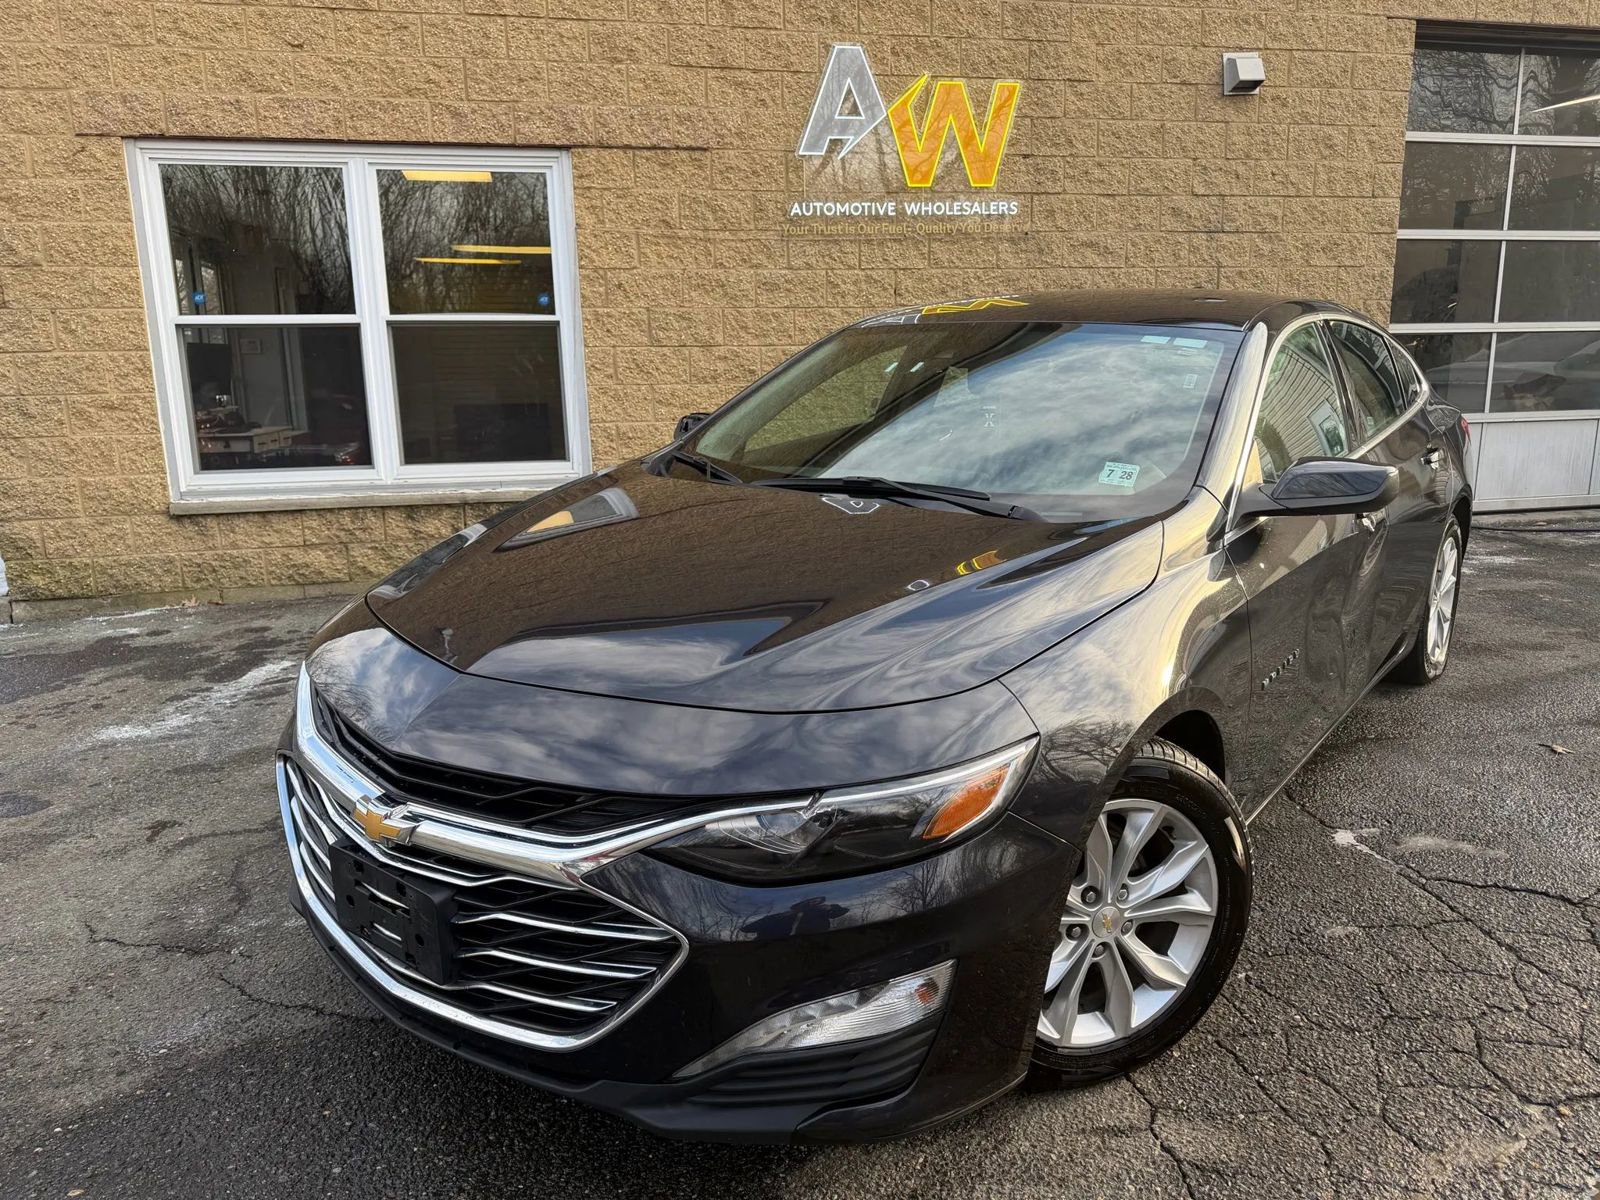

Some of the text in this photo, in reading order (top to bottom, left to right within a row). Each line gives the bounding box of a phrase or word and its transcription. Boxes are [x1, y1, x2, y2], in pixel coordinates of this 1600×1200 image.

[790, 201, 1018, 216] AUTOMOTIVE WHOLESALERS
[782, 224, 809, 235] Your
[811, 223, 844, 234] Trust
[857, 223, 880, 234] Our
[882, 223, 906, 234] Fuel
[916, 222, 957, 235] Quality
[960, 222, 981, 233] You
[1106, 469, 1133, 480] 7 28
